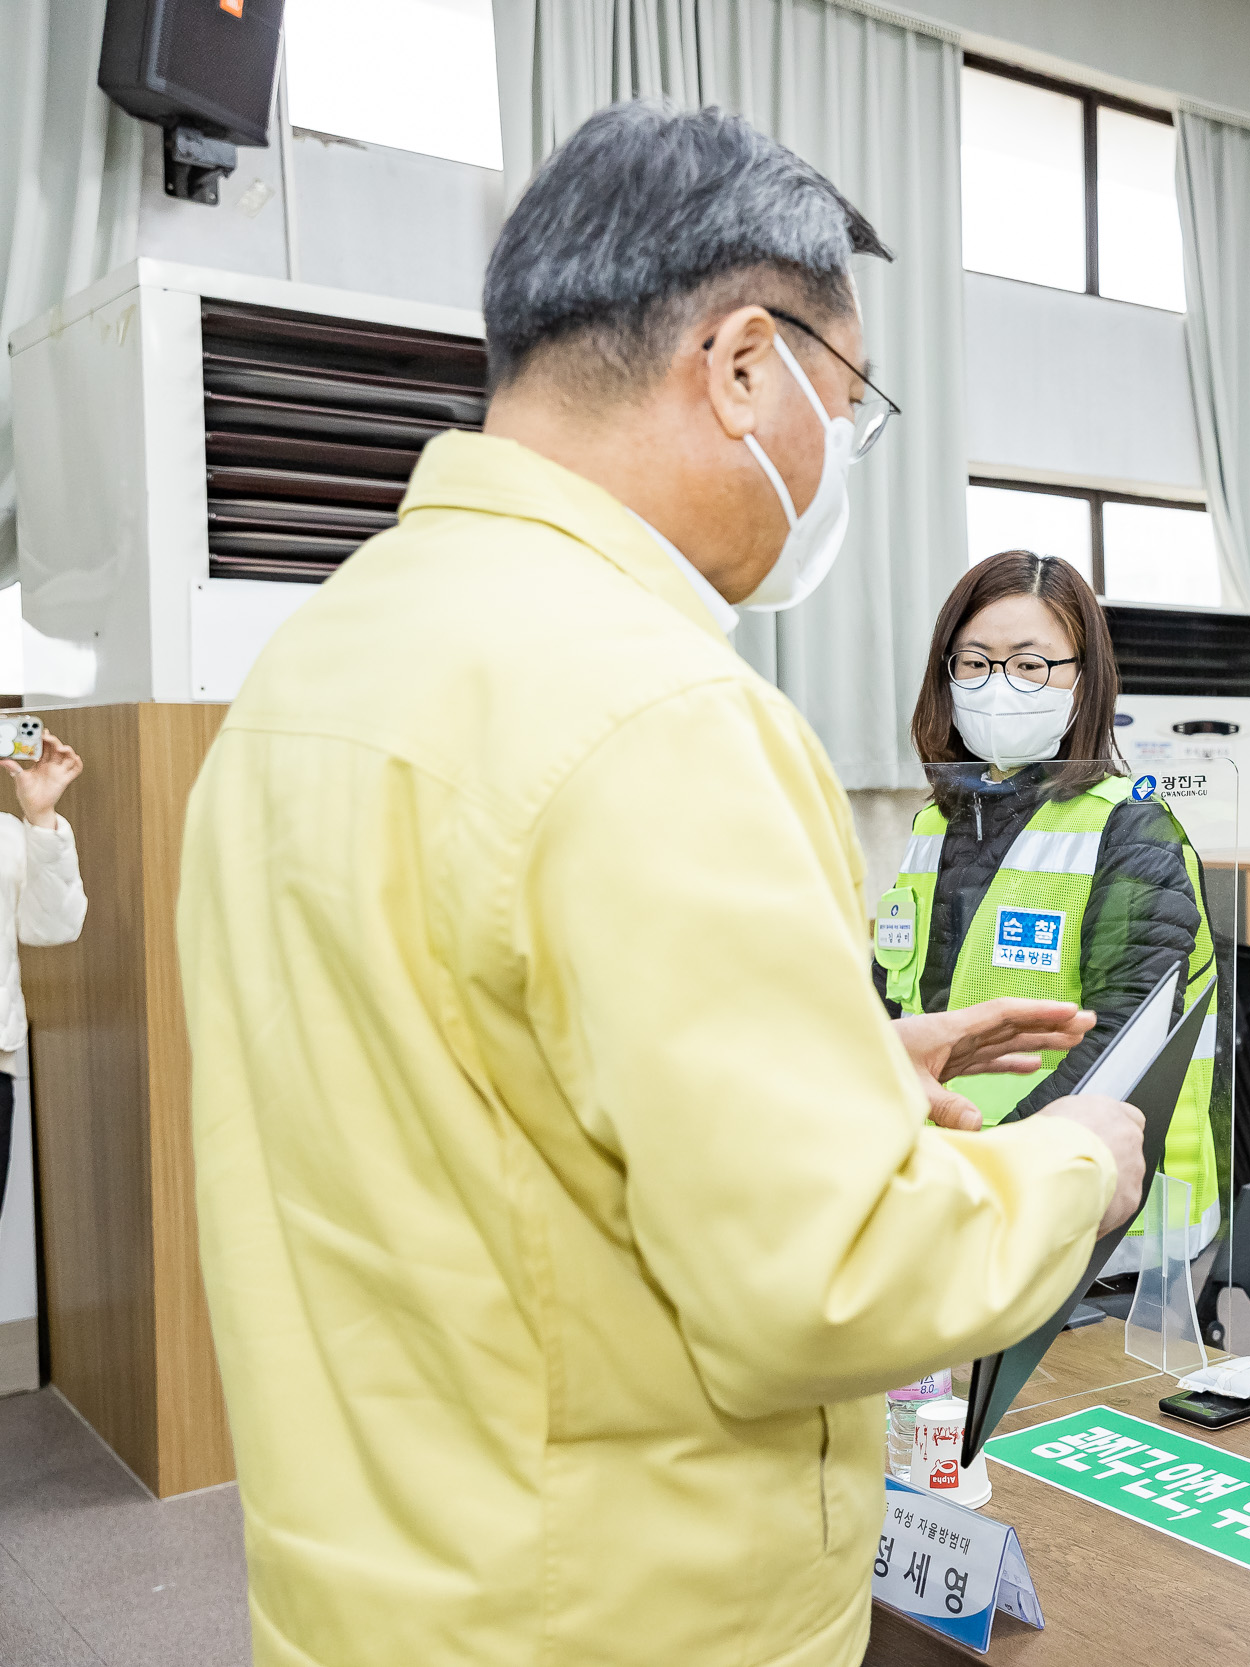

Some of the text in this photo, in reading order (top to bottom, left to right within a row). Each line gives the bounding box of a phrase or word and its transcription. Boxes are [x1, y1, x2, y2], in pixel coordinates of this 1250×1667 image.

[1161, 774, 1208, 790] 광진구
[1160, 789, 1208, 798] GWANGJIN-GU
[1003, 918, 1056, 944] 순찰
[1001, 948, 1052, 965] 자율방범
[920, 1383, 935, 1395] 8.0
[1031, 1426, 1180, 1480] 광진구
[932, 1475, 956, 1485] Alpha
[893, 1507, 915, 1529] 여성
[917, 1518, 971, 1556] 자율방범대
